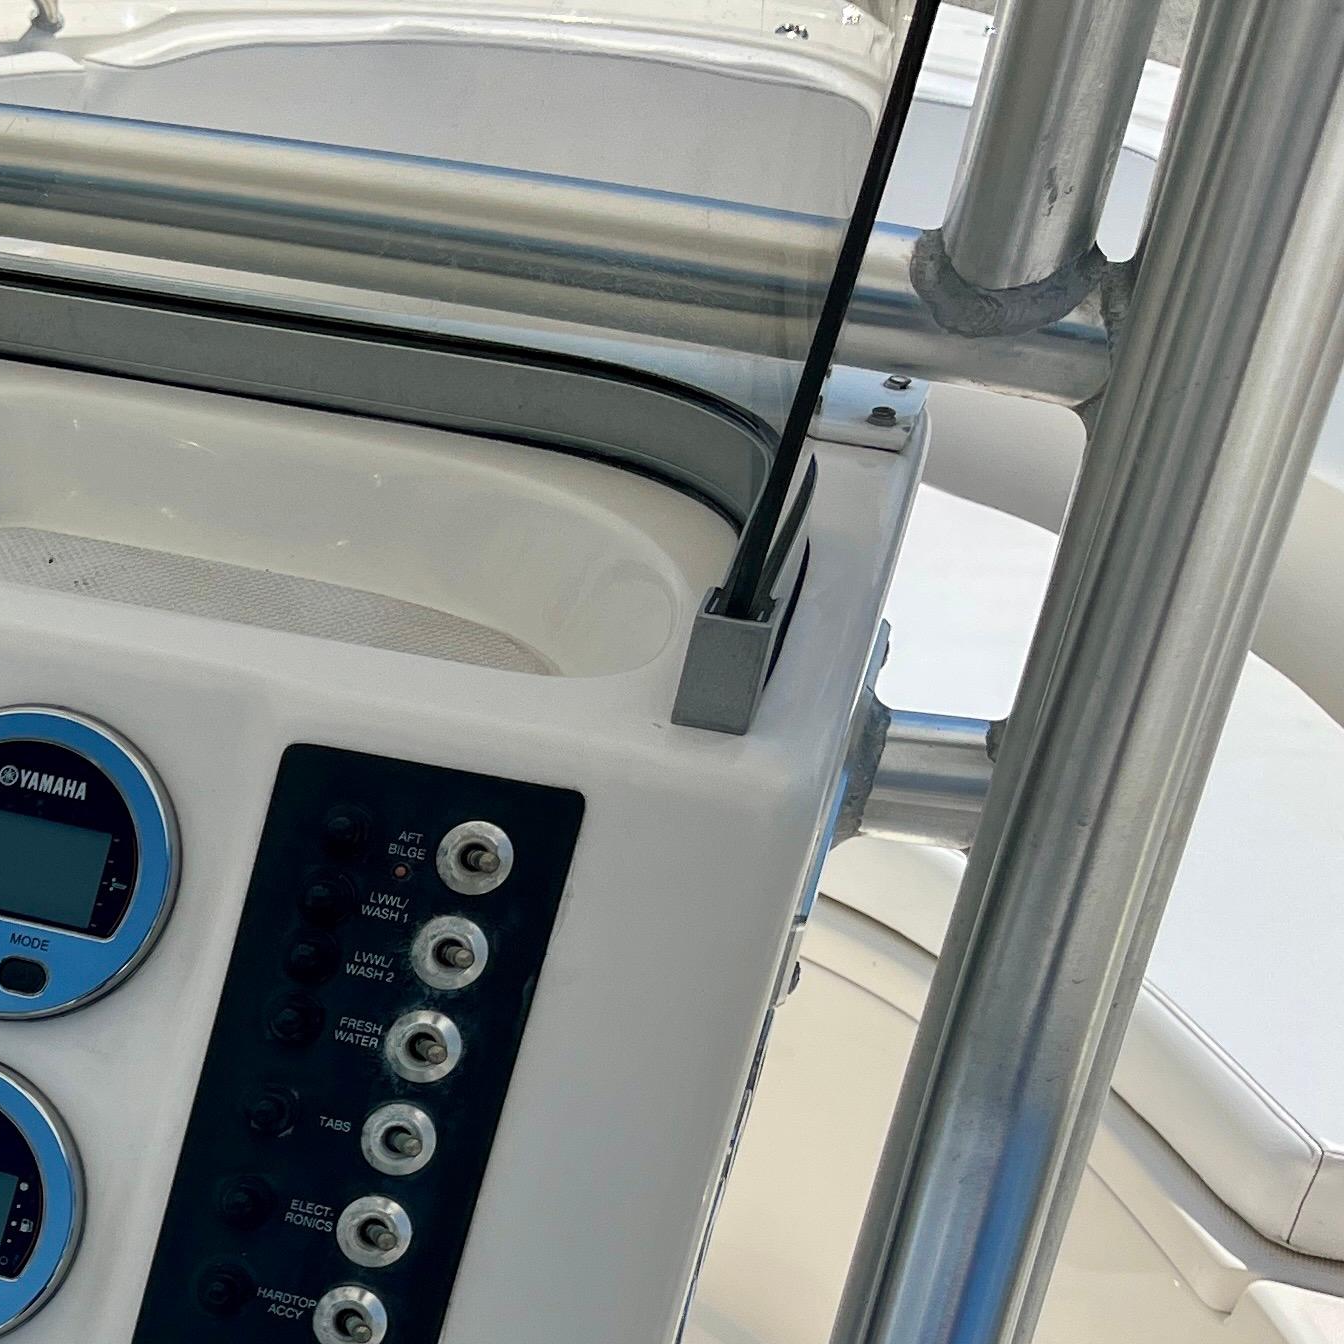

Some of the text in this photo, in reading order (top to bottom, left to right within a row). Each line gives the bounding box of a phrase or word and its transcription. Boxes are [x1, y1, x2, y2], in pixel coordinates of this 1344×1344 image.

[19, 769, 87, 800] YAMAHA
[398, 831, 424, 845] AFT
[388, 843, 426, 861] BILGE
[362, 904, 409, 924] WASH 1
[9, 933, 50, 951] MODE
[345, 963, 395, 983] WASH 2
[339, 1016, 384, 1035] FRESH
[334, 1030, 380, 1049] WATER
[319, 1115, 352, 1133] TABS
[290, 1199, 335, 1218] ELECT-
[284, 1211, 334, 1233] RONICS
[256, 1286, 318, 1310] HARDTOP
[267, 1303, 305, 1321] ACCY
